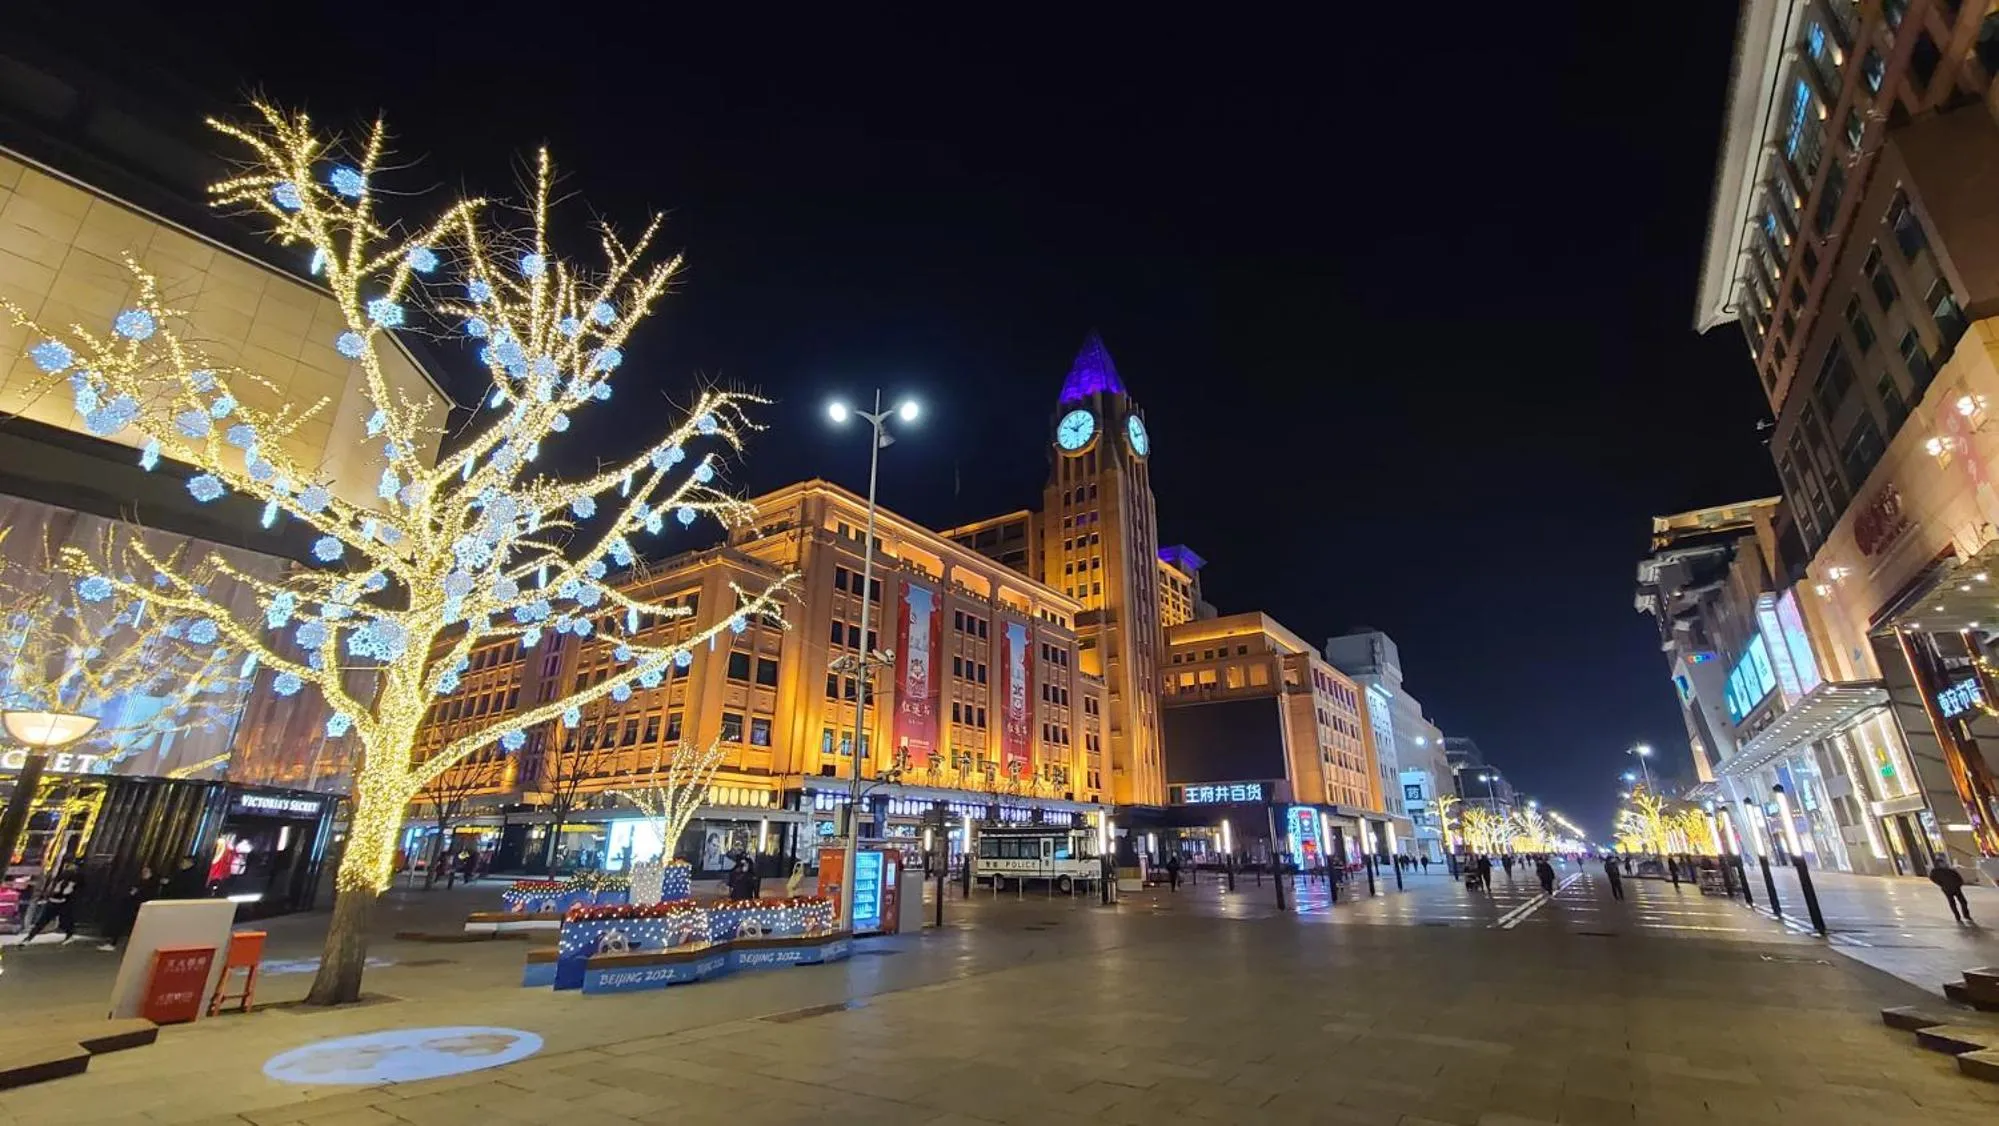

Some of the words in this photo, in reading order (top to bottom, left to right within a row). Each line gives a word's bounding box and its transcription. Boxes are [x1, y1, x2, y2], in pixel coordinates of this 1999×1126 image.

[1184, 783, 1263, 804] 王府井百货
[241, 794, 289, 810] VICTORIA'S
[289, 800, 321, 813] SECRET
[739, 952, 774, 965] BEIJING
[776, 951, 803, 961] 2022
[599, 972, 643, 987] BEIJING
[644, 968, 677, 981] 2022
